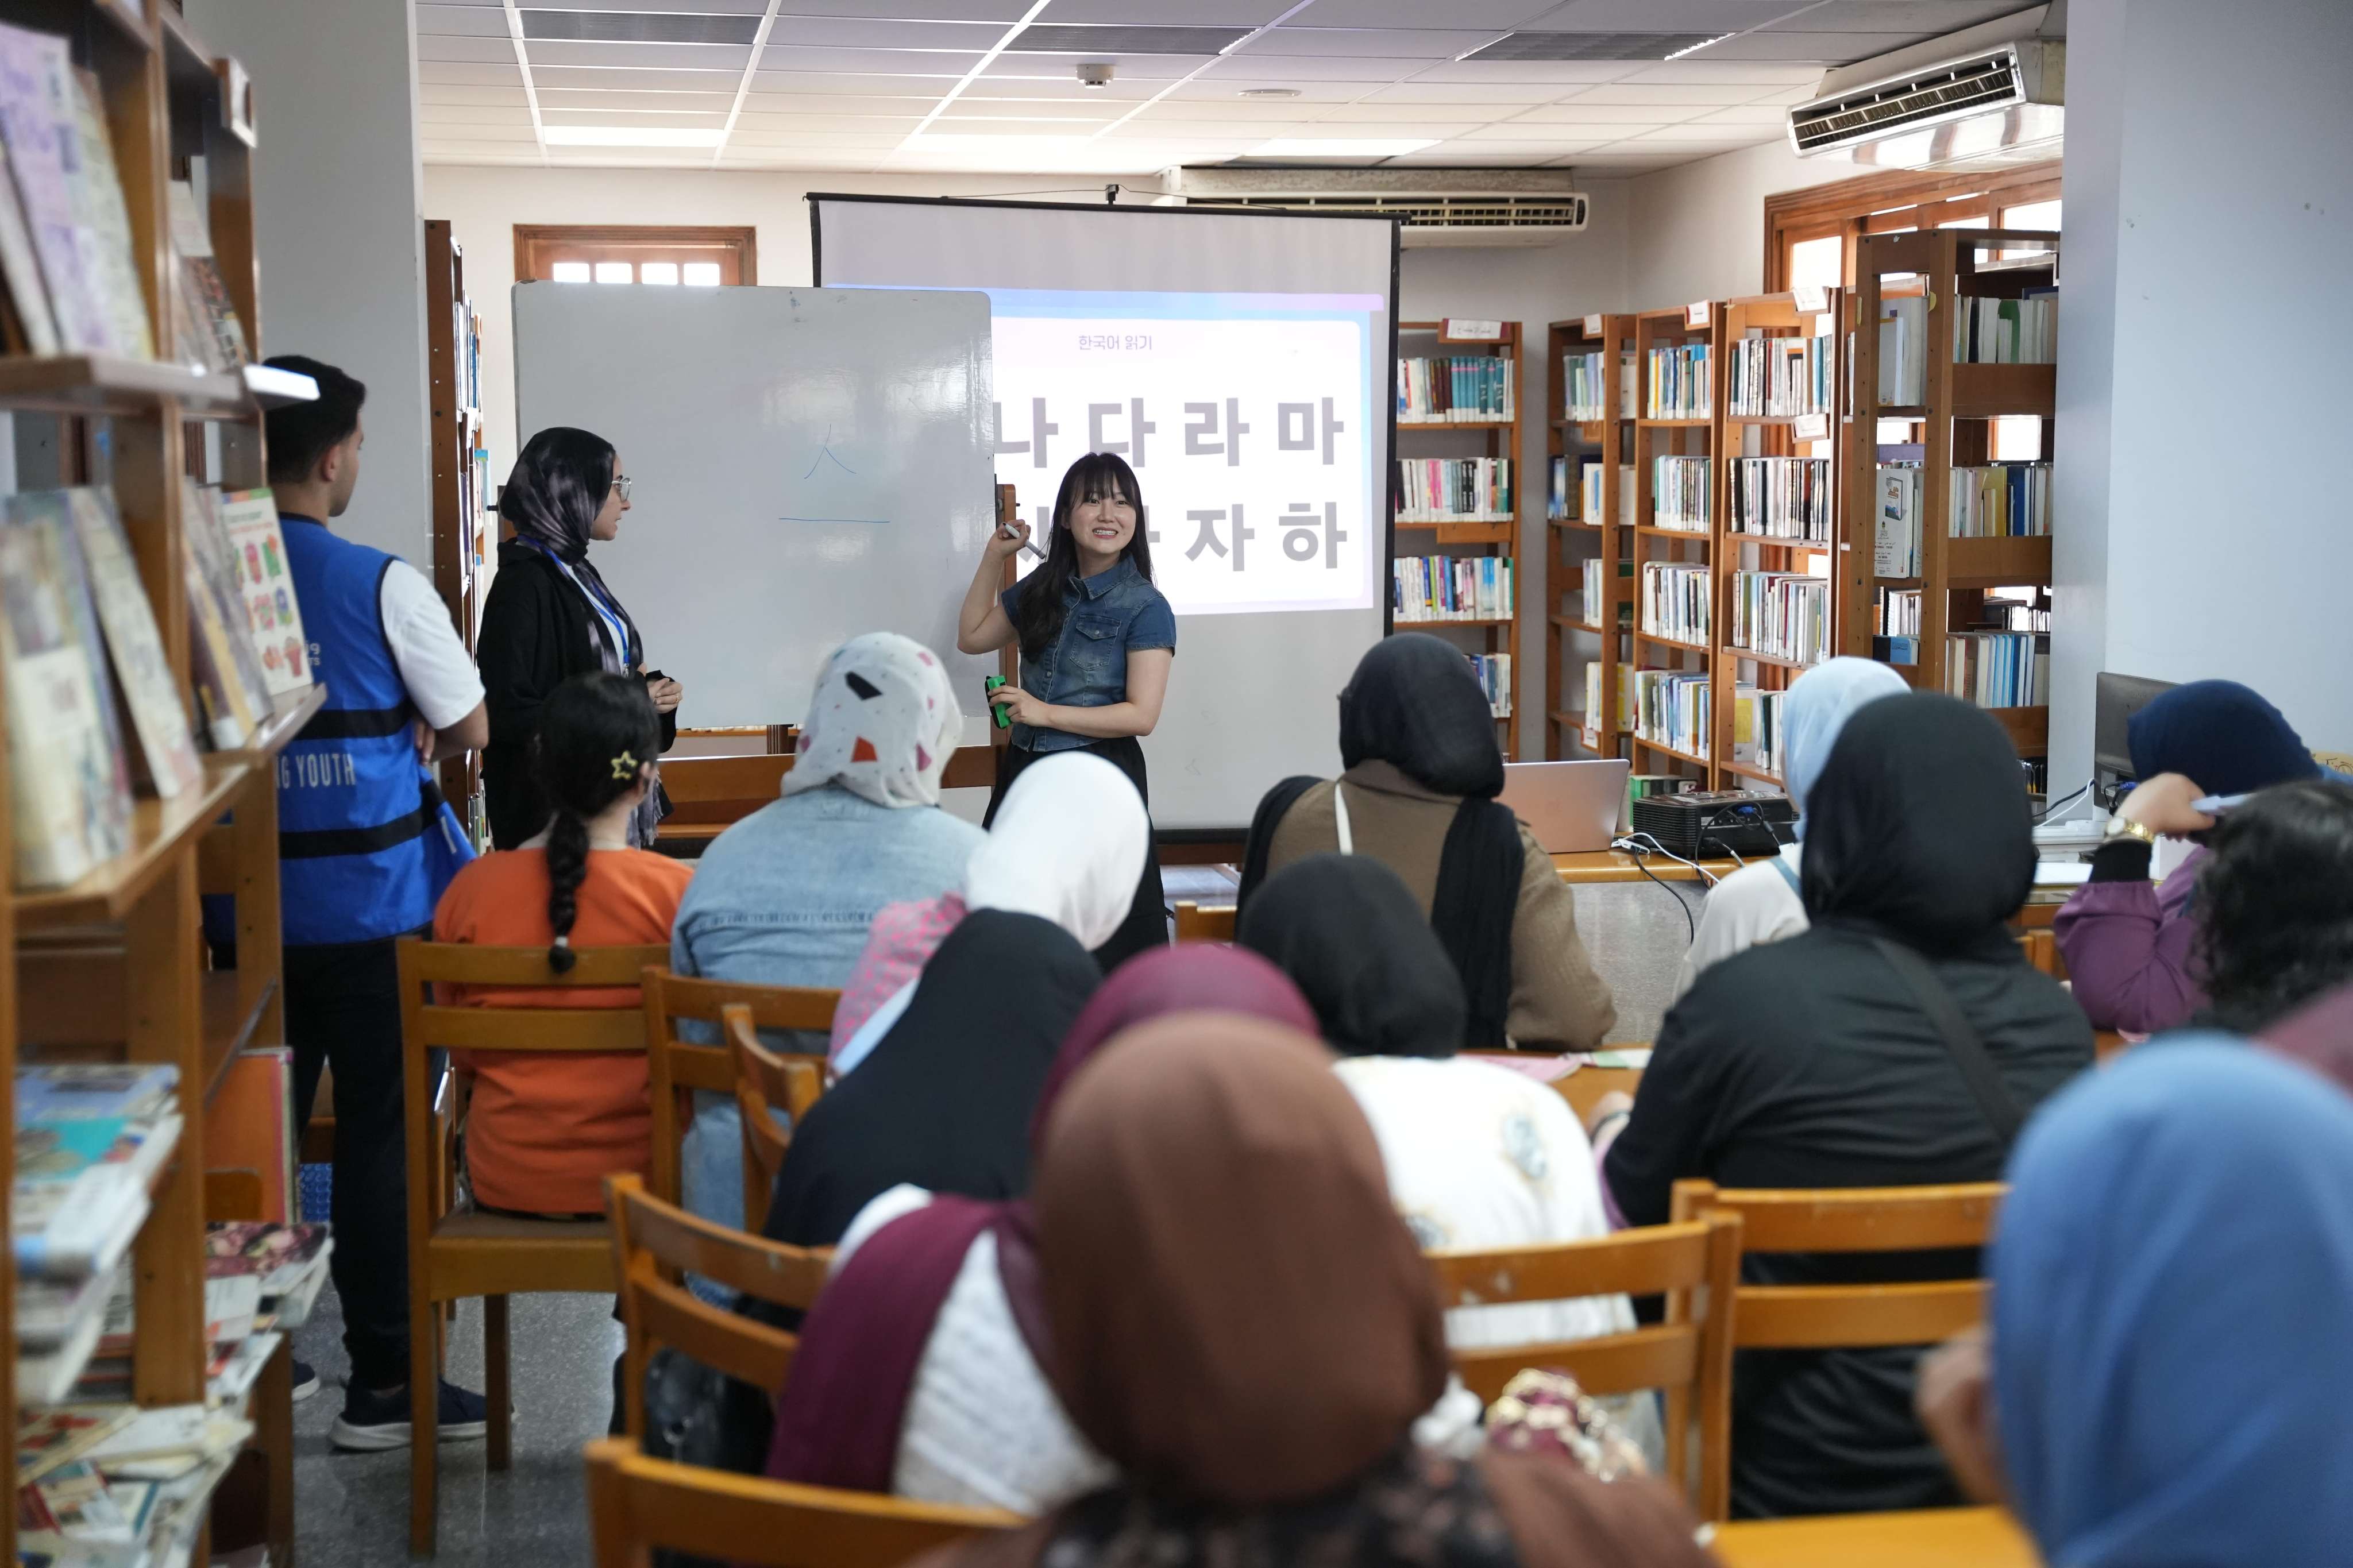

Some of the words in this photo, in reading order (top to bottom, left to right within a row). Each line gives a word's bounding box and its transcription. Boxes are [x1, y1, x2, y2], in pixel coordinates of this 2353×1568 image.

[1079, 335, 1119, 350] 한국어
[1125, 335, 1152, 350] 읽기
[995, 397, 1058, 468] 나
[1088, 397, 1156, 468] 다
[1185, 397, 1249, 466] 라
[1278, 397, 1344, 465] 마
[1185, 504, 1255, 571] 자
[1279, 502, 1347, 569] 하
[296, 753, 356, 789] YOUTH
